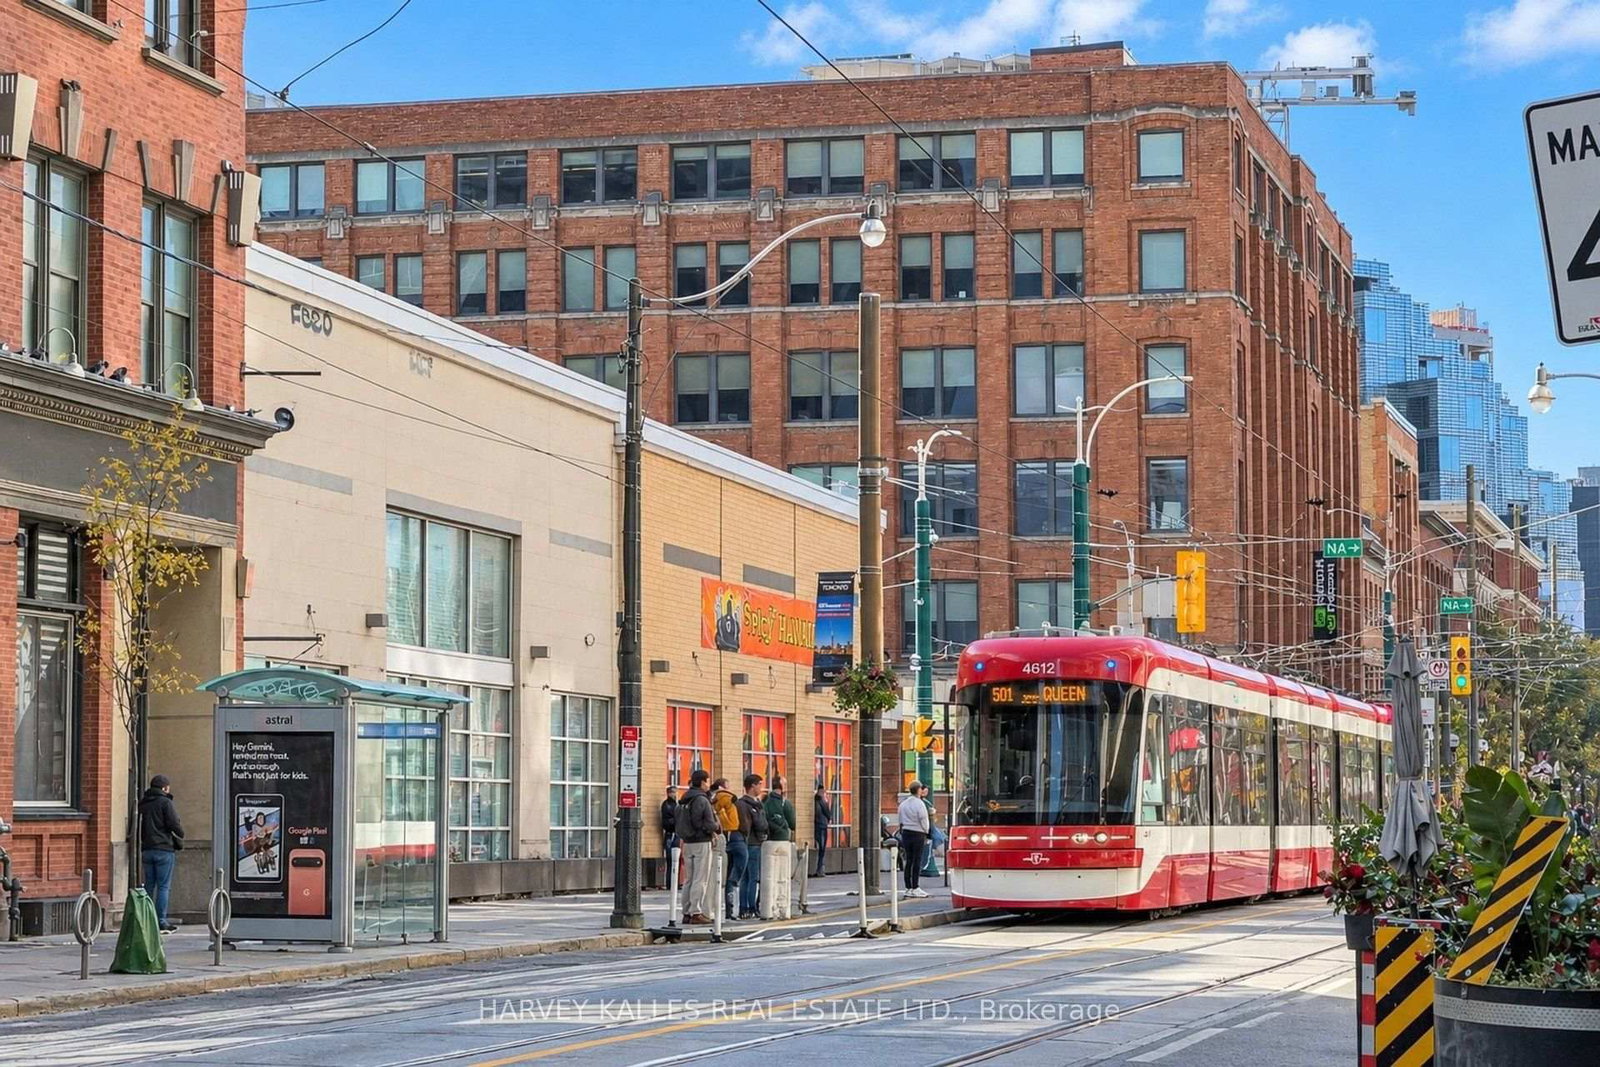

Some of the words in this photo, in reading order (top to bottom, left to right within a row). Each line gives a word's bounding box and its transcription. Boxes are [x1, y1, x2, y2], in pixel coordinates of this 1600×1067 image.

[1547, 123, 1600, 165] MA
[1327, 542, 1347, 554] NA
[1022, 662, 1055, 674] 4612
[992, 686, 1014, 702] 501
[1043, 686, 1086, 702] QUEEN
[265, 715, 293, 725] astral
